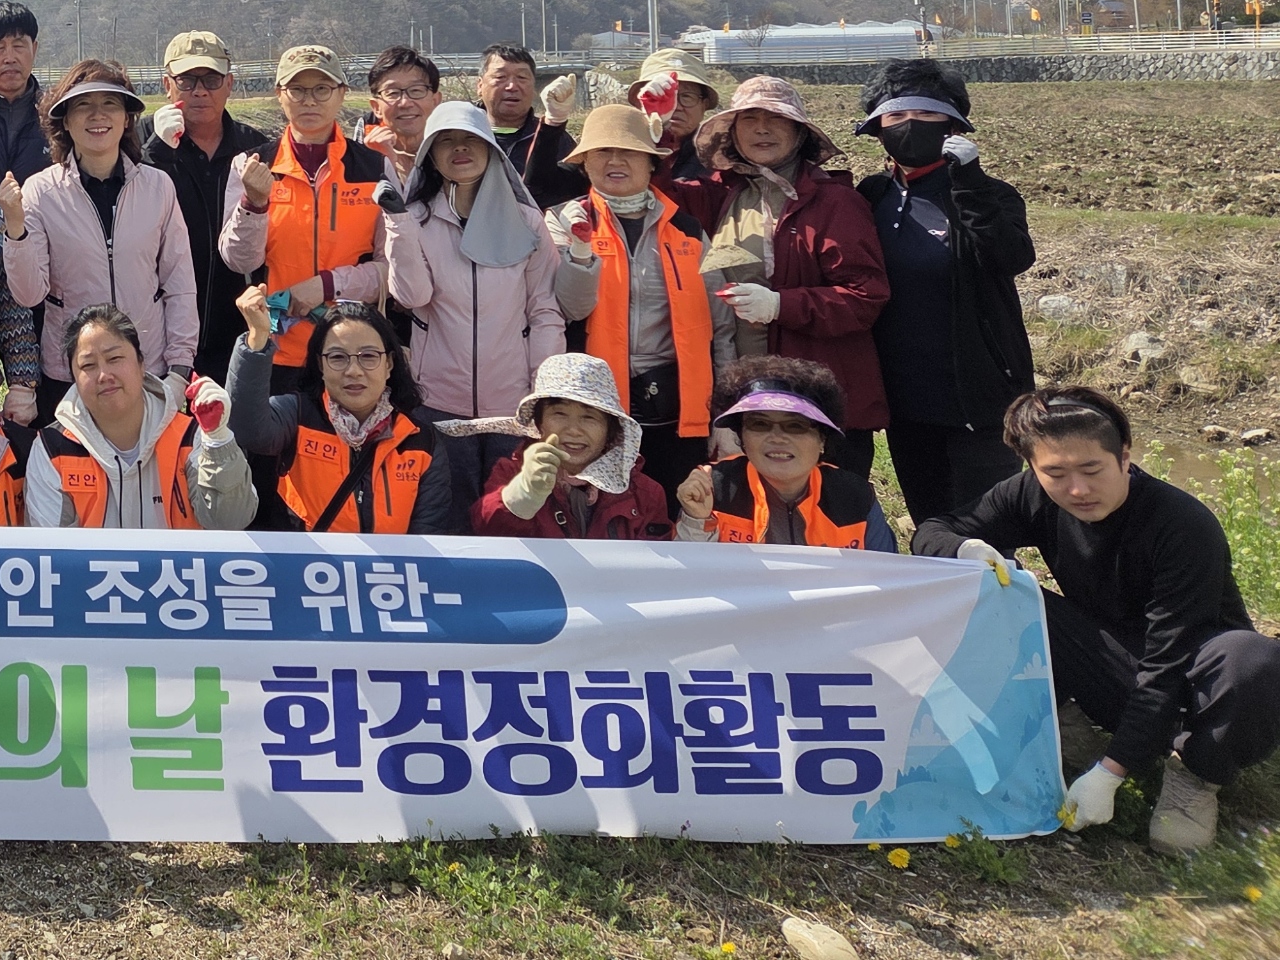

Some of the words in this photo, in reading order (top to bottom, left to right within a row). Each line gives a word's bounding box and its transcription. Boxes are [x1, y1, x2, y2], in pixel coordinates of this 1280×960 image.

[341, 188, 360, 197] 119
[304, 438, 338, 460] 진안
[68, 474, 96, 486] 진안
[85, 559, 276, 631] 조성을
[301, 560, 462, 633] 위한-
[125, 666, 230, 791] 날
[260, 665, 885, 795] 환경정화활동
